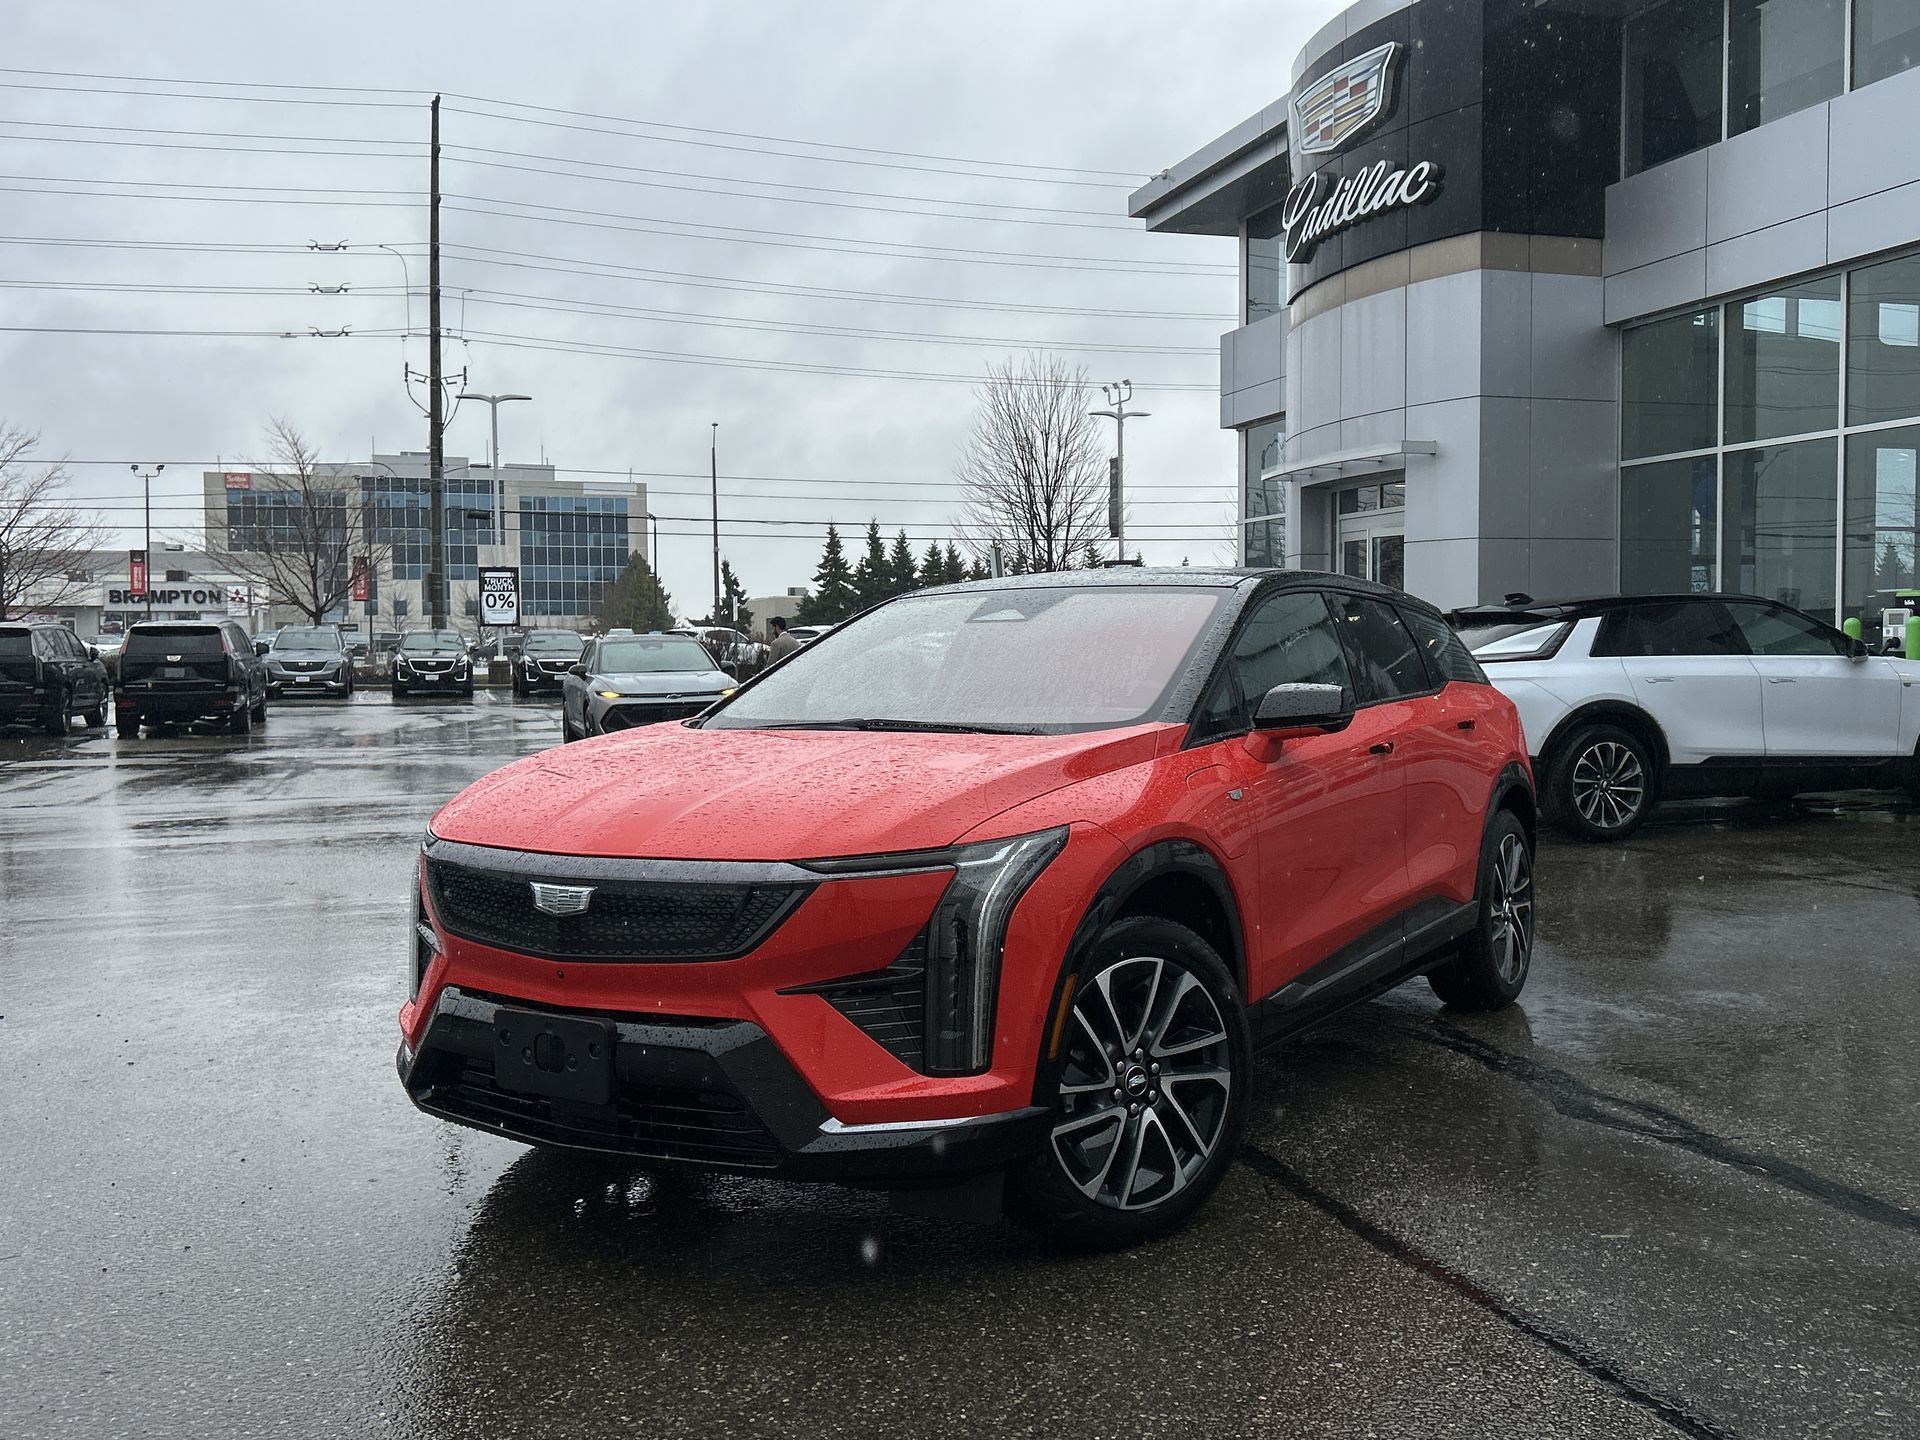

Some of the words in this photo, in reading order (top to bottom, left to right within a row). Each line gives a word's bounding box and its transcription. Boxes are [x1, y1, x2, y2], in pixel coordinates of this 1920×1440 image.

[1282, 159, 1435, 263] Cadillac
[485, 577, 513, 585] TRUCK
[485, 593, 514, 608] 0%
